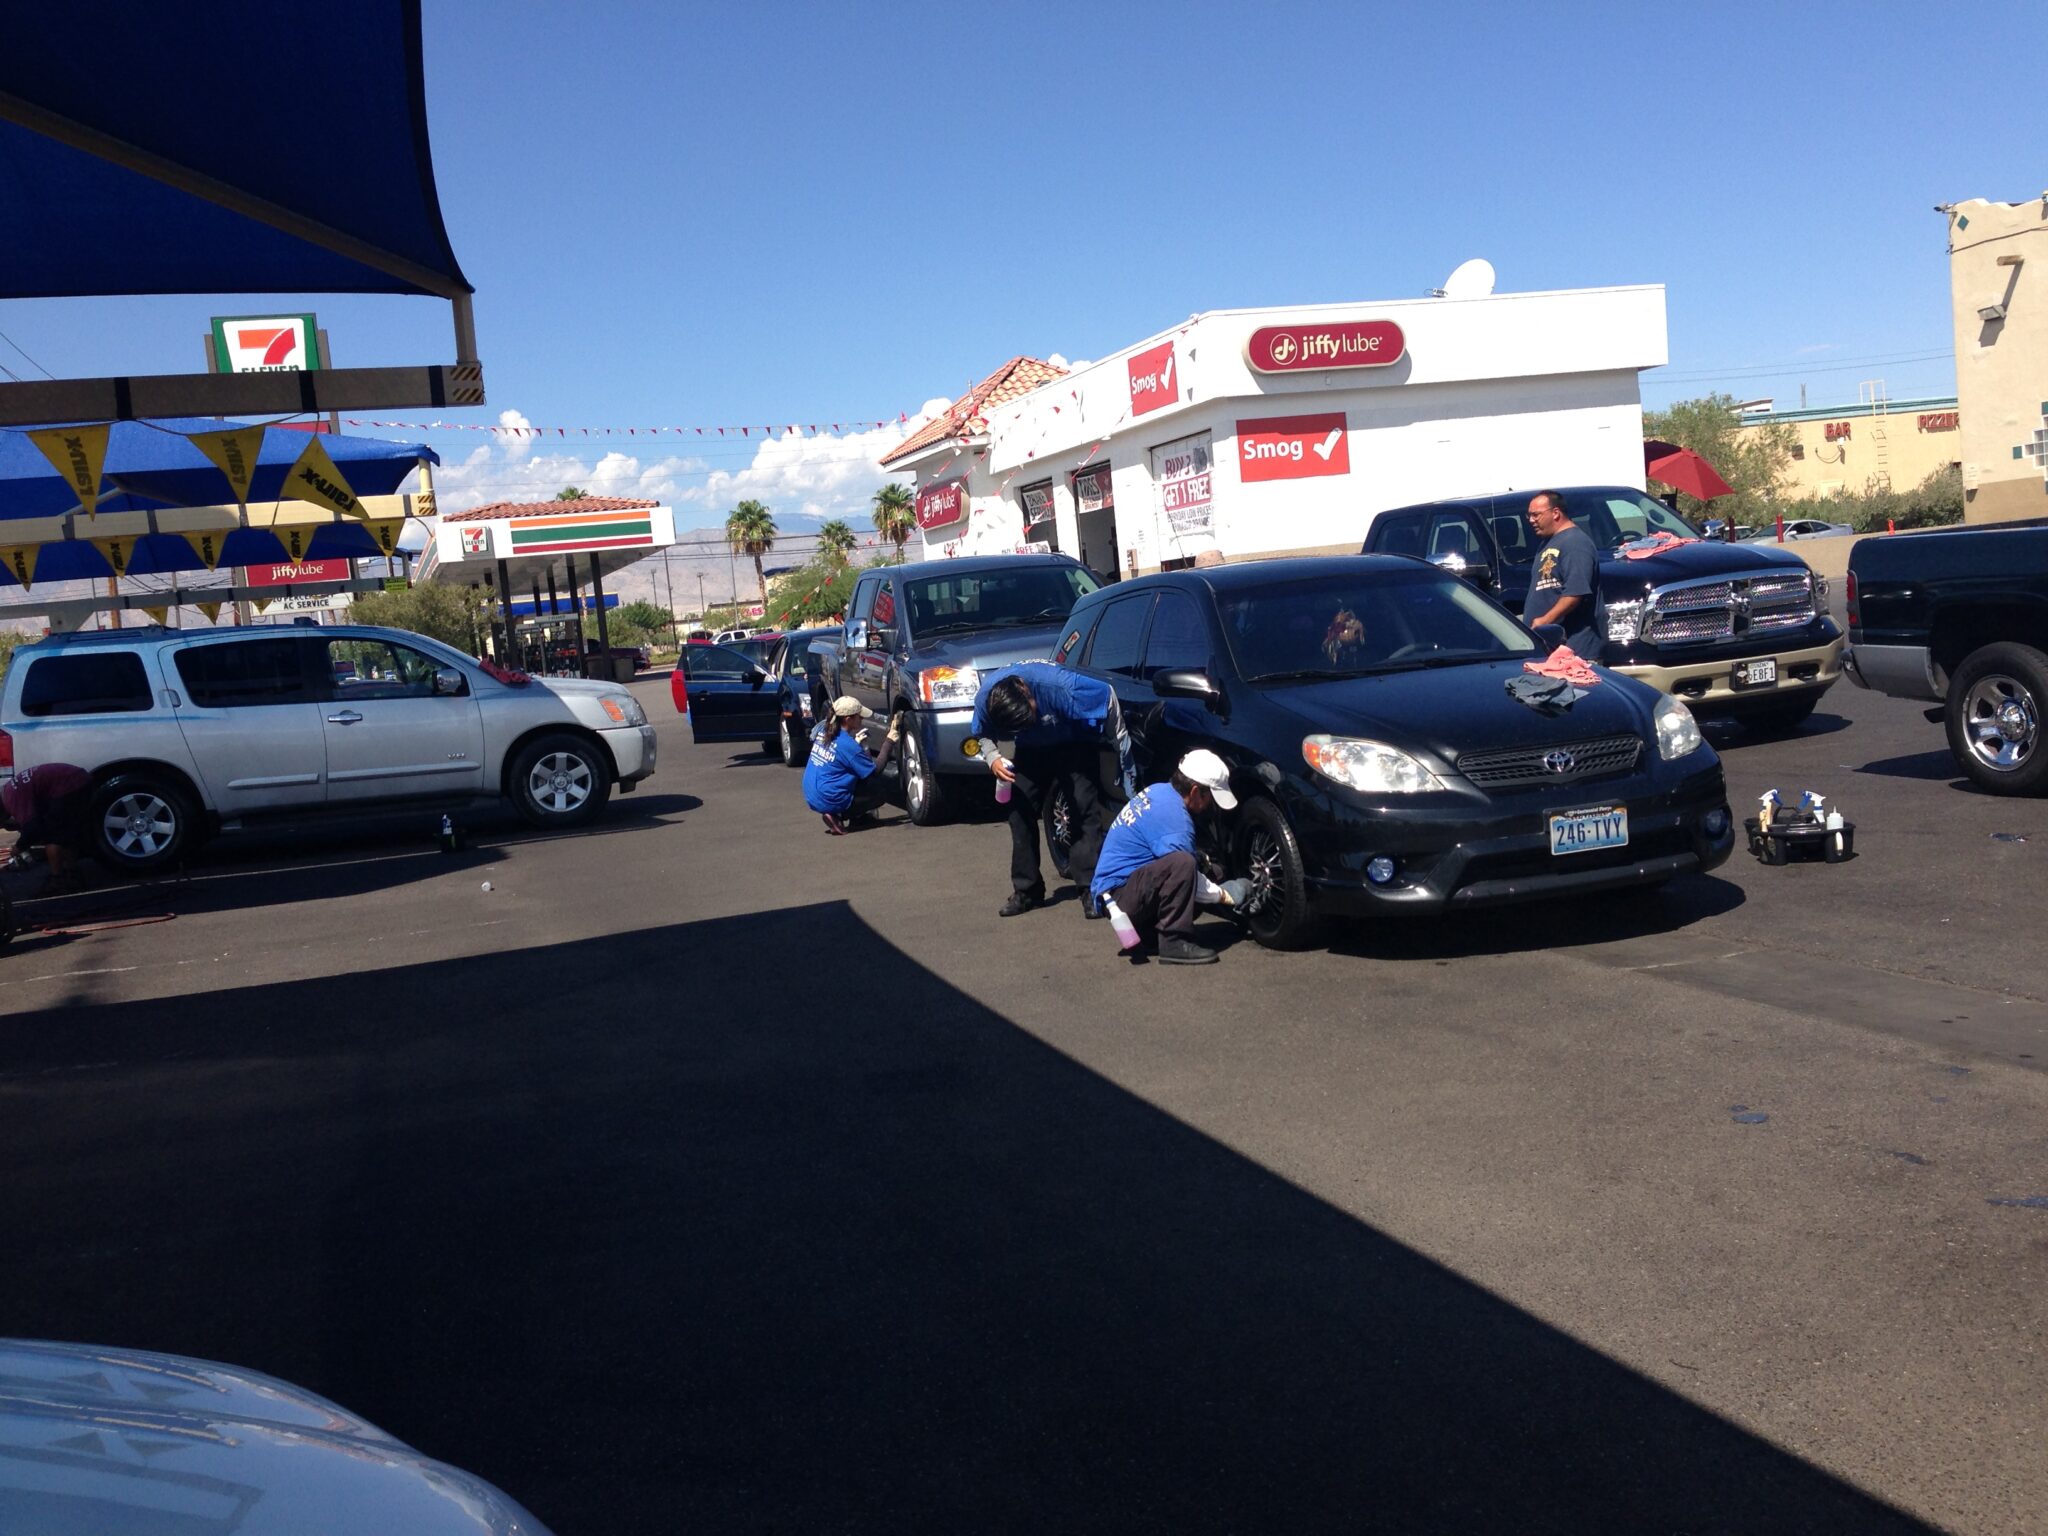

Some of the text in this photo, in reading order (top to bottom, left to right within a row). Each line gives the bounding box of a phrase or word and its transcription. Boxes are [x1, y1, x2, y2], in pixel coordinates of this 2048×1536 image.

[238, 327, 296, 366] 7
[1301, 332, 1379, 361] jiffy lube
[1131, 375, 1157, 395] Smog
[1824, 422, 1851, 441] BAR
[1243, 439, 1303, 461] Smog
[1165, 456, 1184, 480] BUY
[1164, 476, 1210, 508] GET 1 FREE
[271, 564, 324, 580] jiffy lube
[284, 599, 329, 610] AC SERVICE
